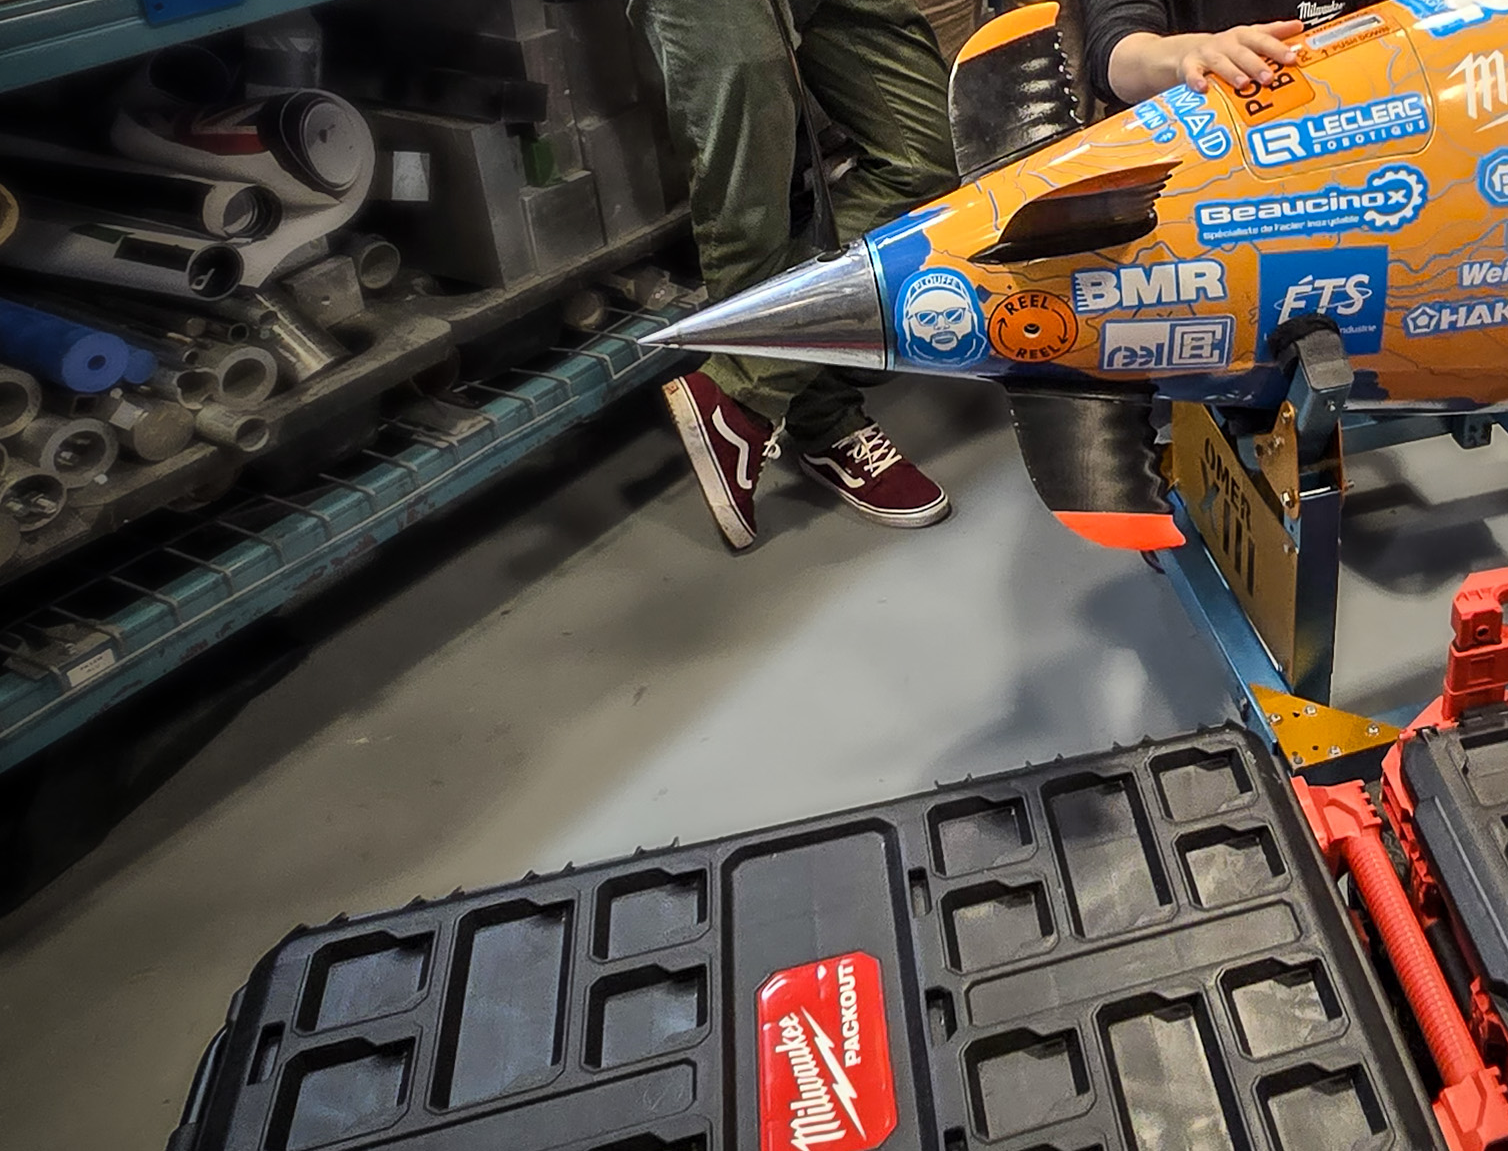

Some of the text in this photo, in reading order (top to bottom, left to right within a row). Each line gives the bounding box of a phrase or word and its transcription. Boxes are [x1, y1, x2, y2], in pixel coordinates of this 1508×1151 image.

[1306, 96, 1422, 138] LECLERC
[1314, 120, 1427, 154] ROBOTIQUE
[1200, 188, 1408, 226] Beaucinox
[1004, 294, 1050, 316] REEL
[1075, 260, 1225, 312] BMR
[1277, 274, 1371, 326] ÉTS
[1015, 342, 1062, 360] REEL
[1203, 437, 1252, 527] OMER
[837, 956, 862, 1068] PACKOUT
[774, 1011, 847, 1151] Milwaukee
